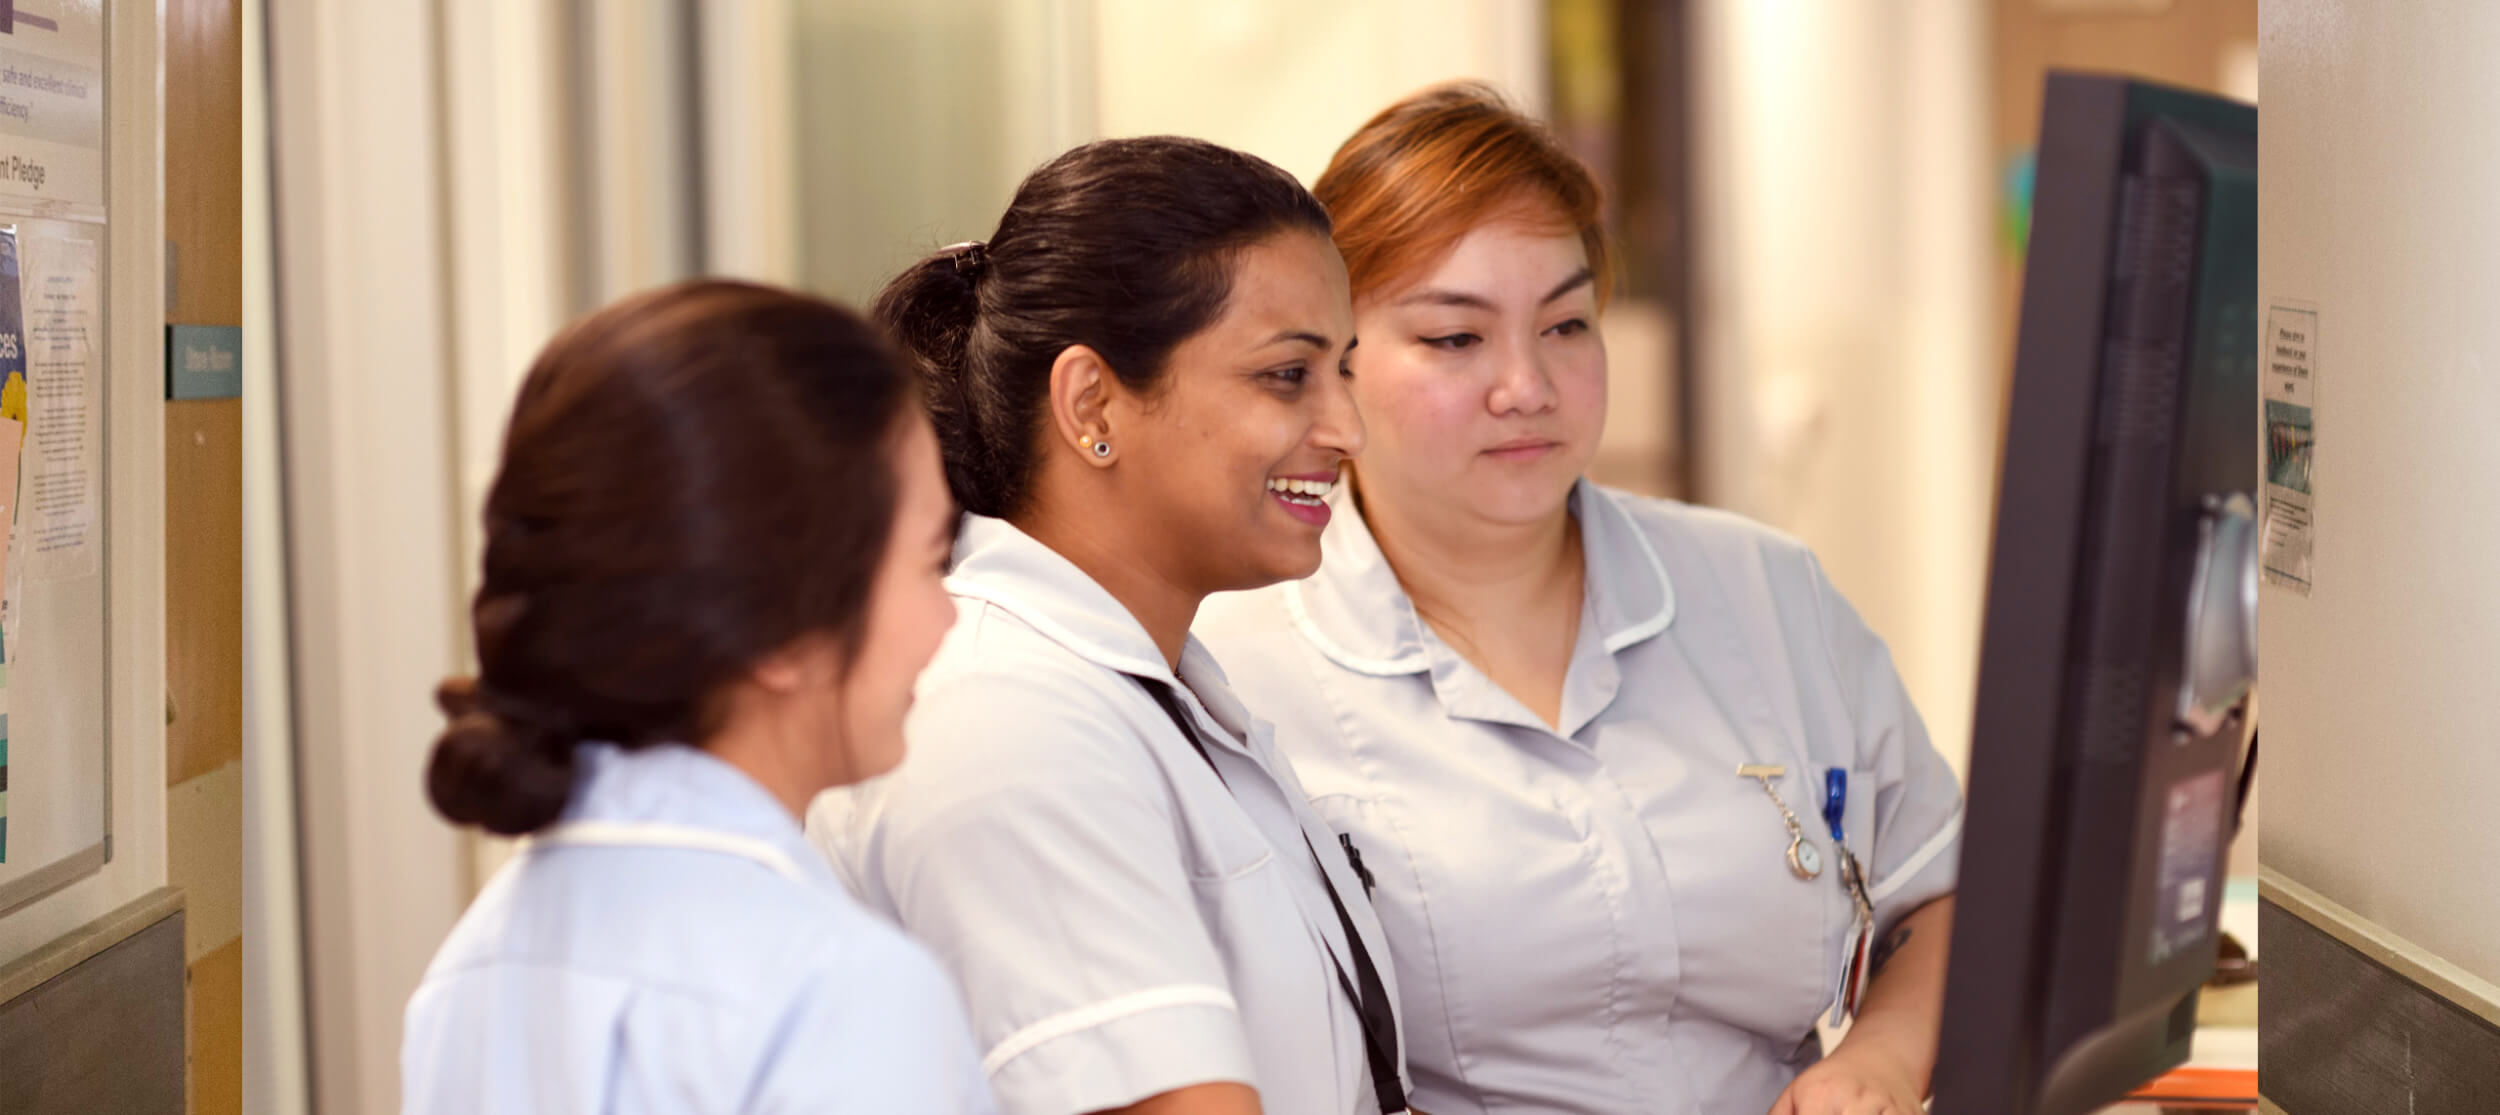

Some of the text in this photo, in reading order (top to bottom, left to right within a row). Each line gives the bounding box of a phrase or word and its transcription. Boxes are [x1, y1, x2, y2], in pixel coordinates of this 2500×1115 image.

[2, 65, 17, 85] safe
[19, 69, 32, 88] and
[33, 74, 64, 94] excellent
[12, 155, 46, 190] Pledge
